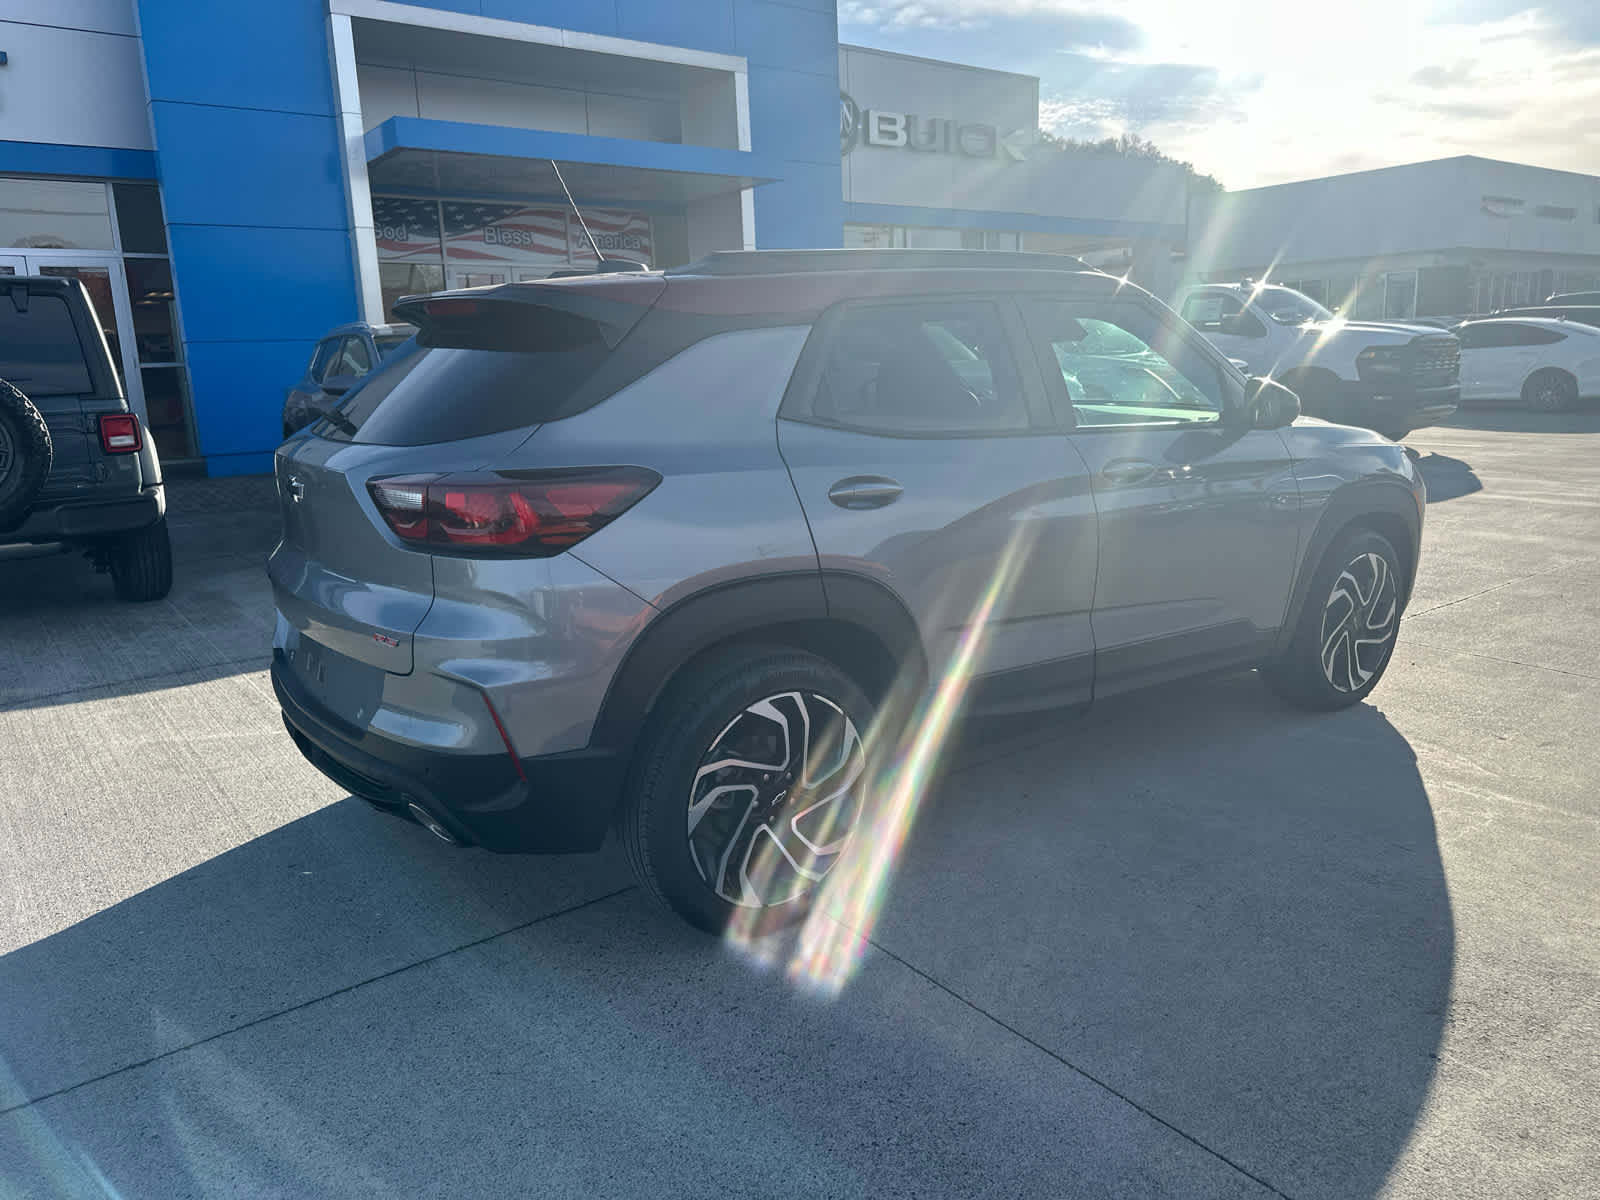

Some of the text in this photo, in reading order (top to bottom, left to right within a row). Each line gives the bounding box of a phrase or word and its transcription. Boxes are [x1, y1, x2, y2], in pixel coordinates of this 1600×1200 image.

[868, 110, 1026, 161] BUICK
[484, 227, 532, 246] Bless
[577, 232, 641, 250] America
